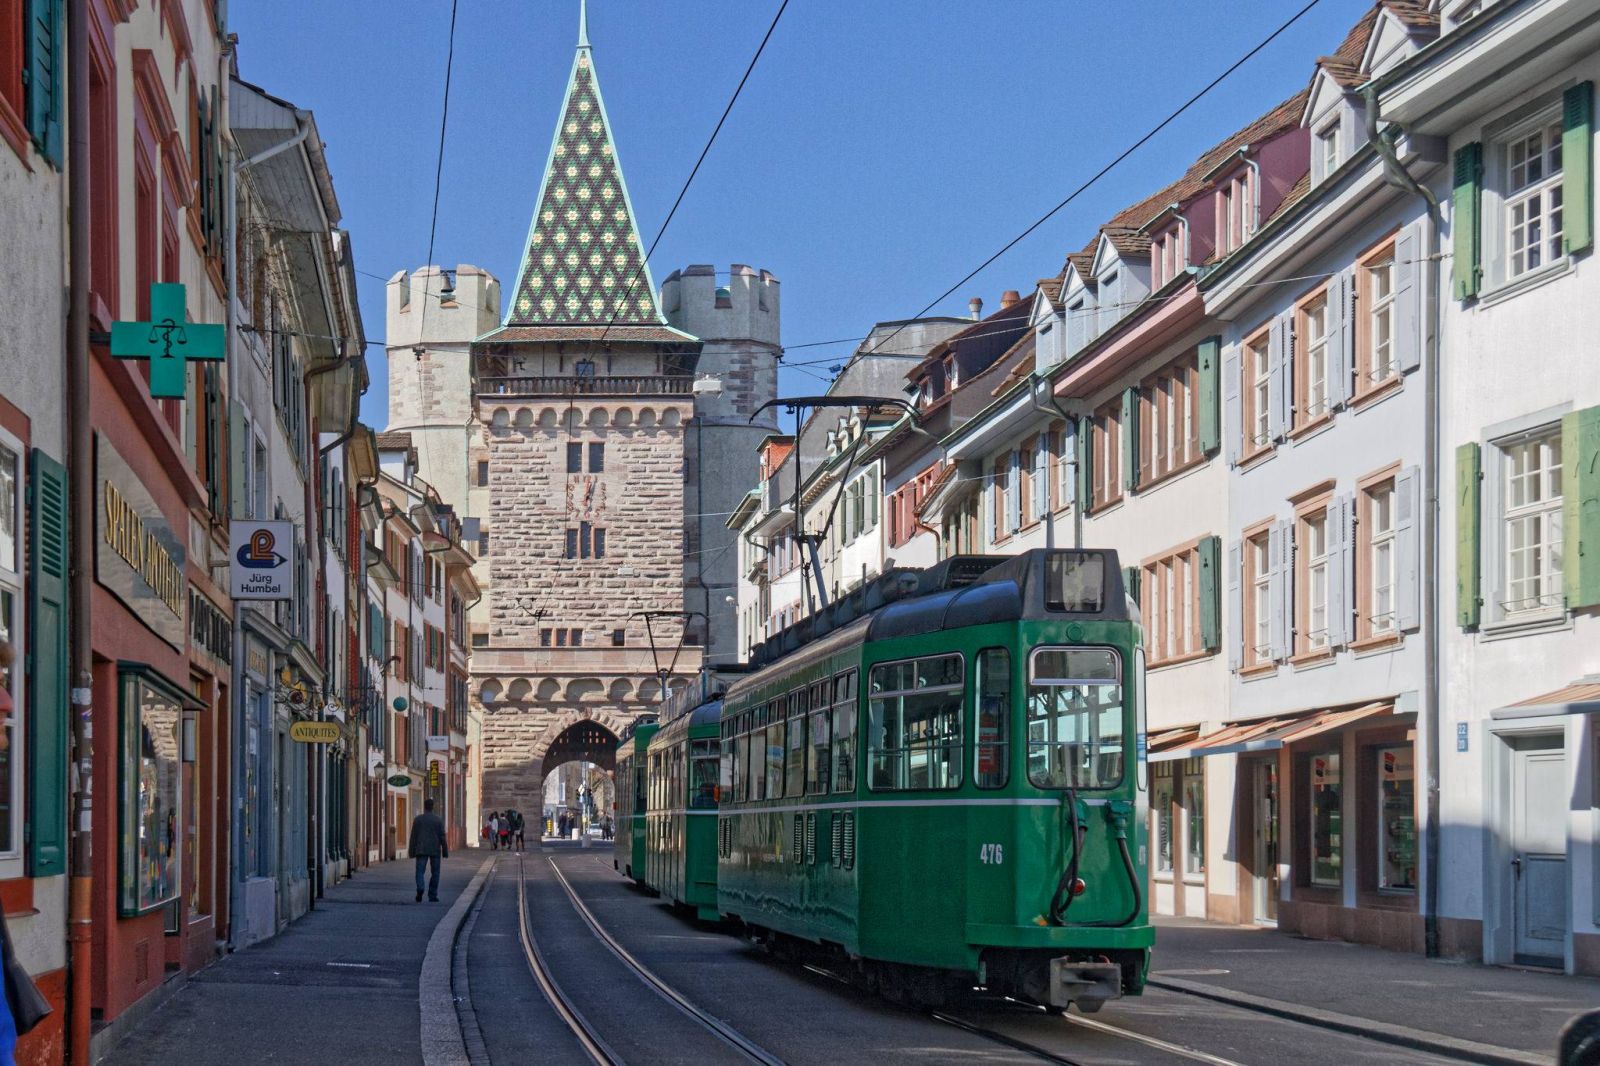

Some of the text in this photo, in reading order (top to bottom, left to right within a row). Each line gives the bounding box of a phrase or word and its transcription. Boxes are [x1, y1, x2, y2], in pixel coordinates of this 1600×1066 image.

[104, 479, 145, 575] SPALEN
[249, 573, 272, 585] Jürg
[241, 584, 281, 593] Humbel
[980, 843, 1003, 864] 476
